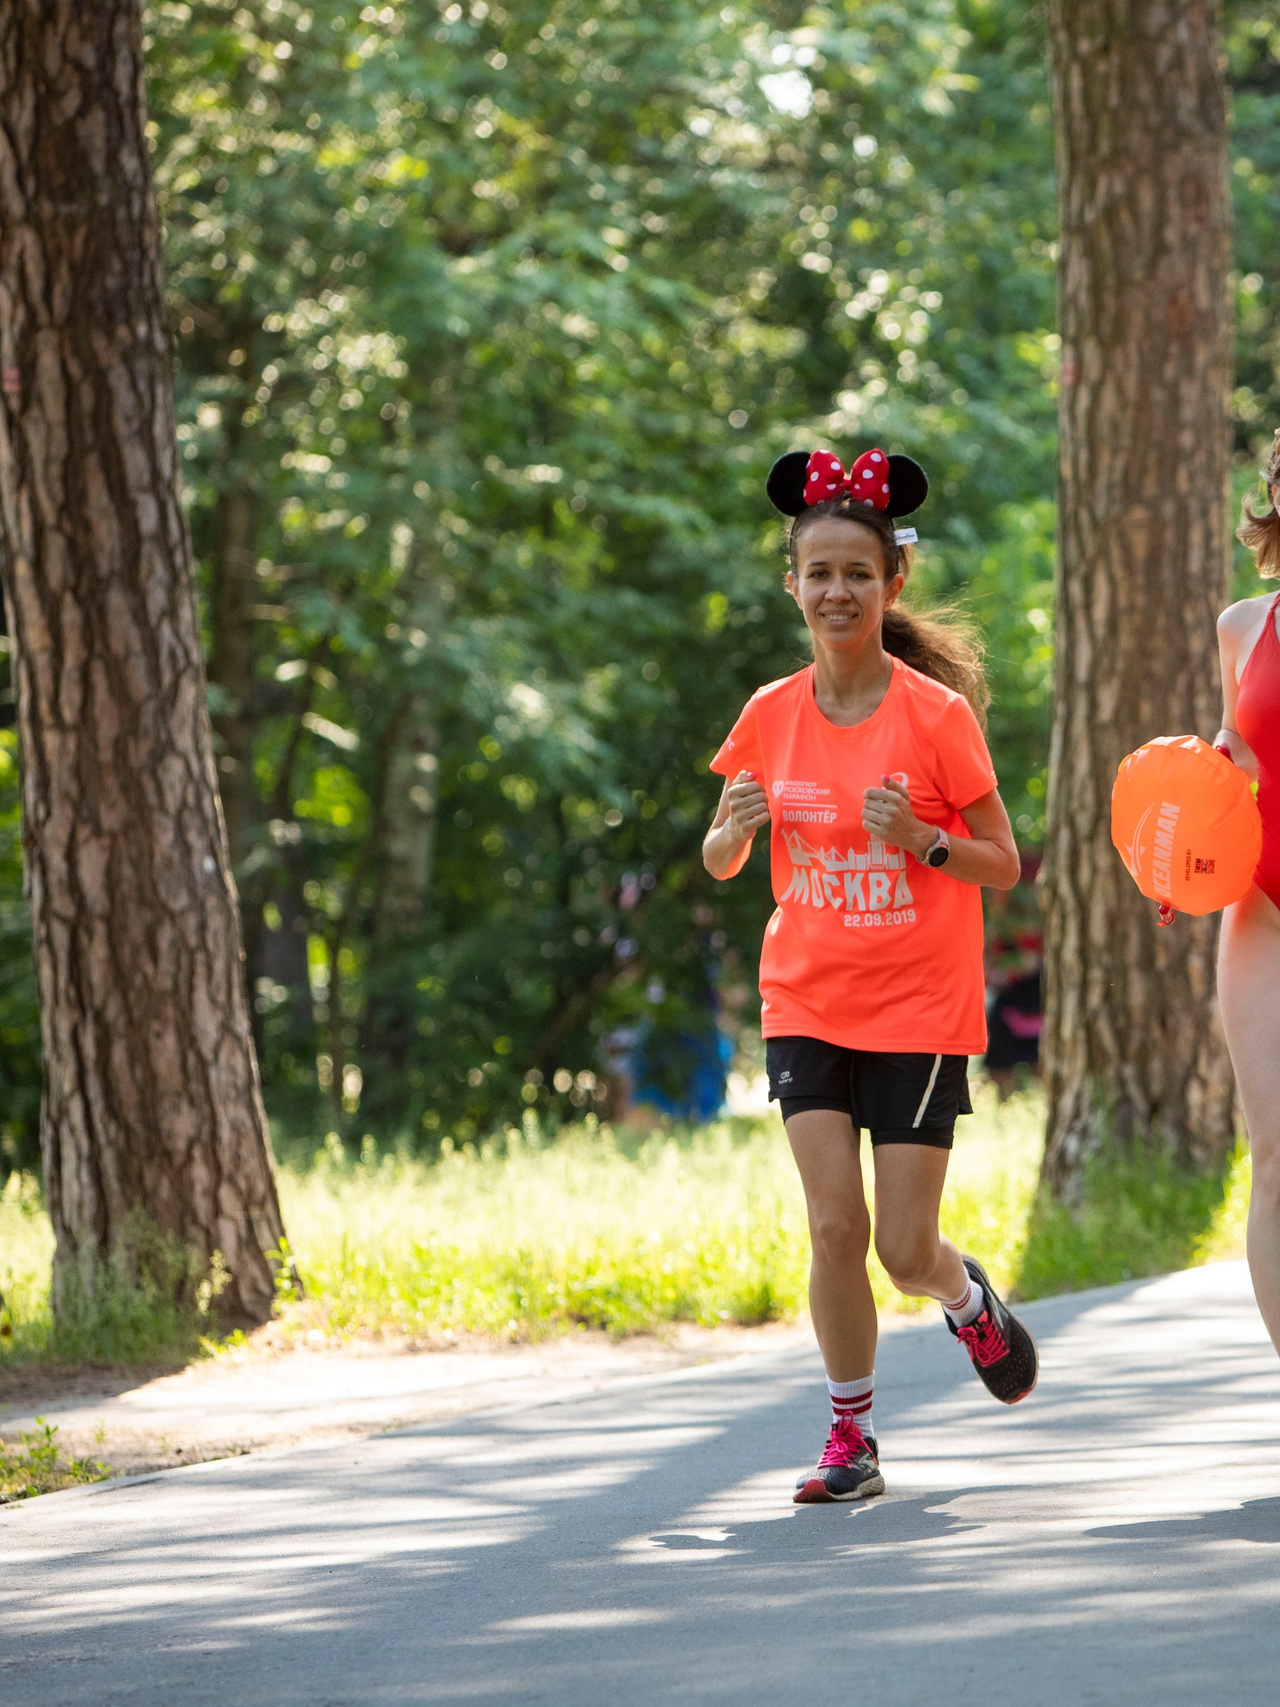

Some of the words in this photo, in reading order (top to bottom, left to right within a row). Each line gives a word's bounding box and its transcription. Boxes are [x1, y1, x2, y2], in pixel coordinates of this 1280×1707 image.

[783, 793, 817, 801] МАРАФОН
[784, 786, 830, 795] МОСКОВСКИЙ
[782, 810, 837, 823] ВОЛОНТЁР
[1152, 801, 1180, 898] OCEANMAN
[780, 867, 914, 911] МОСКВА
[844, 909, 916, 927] 22.09.2019
